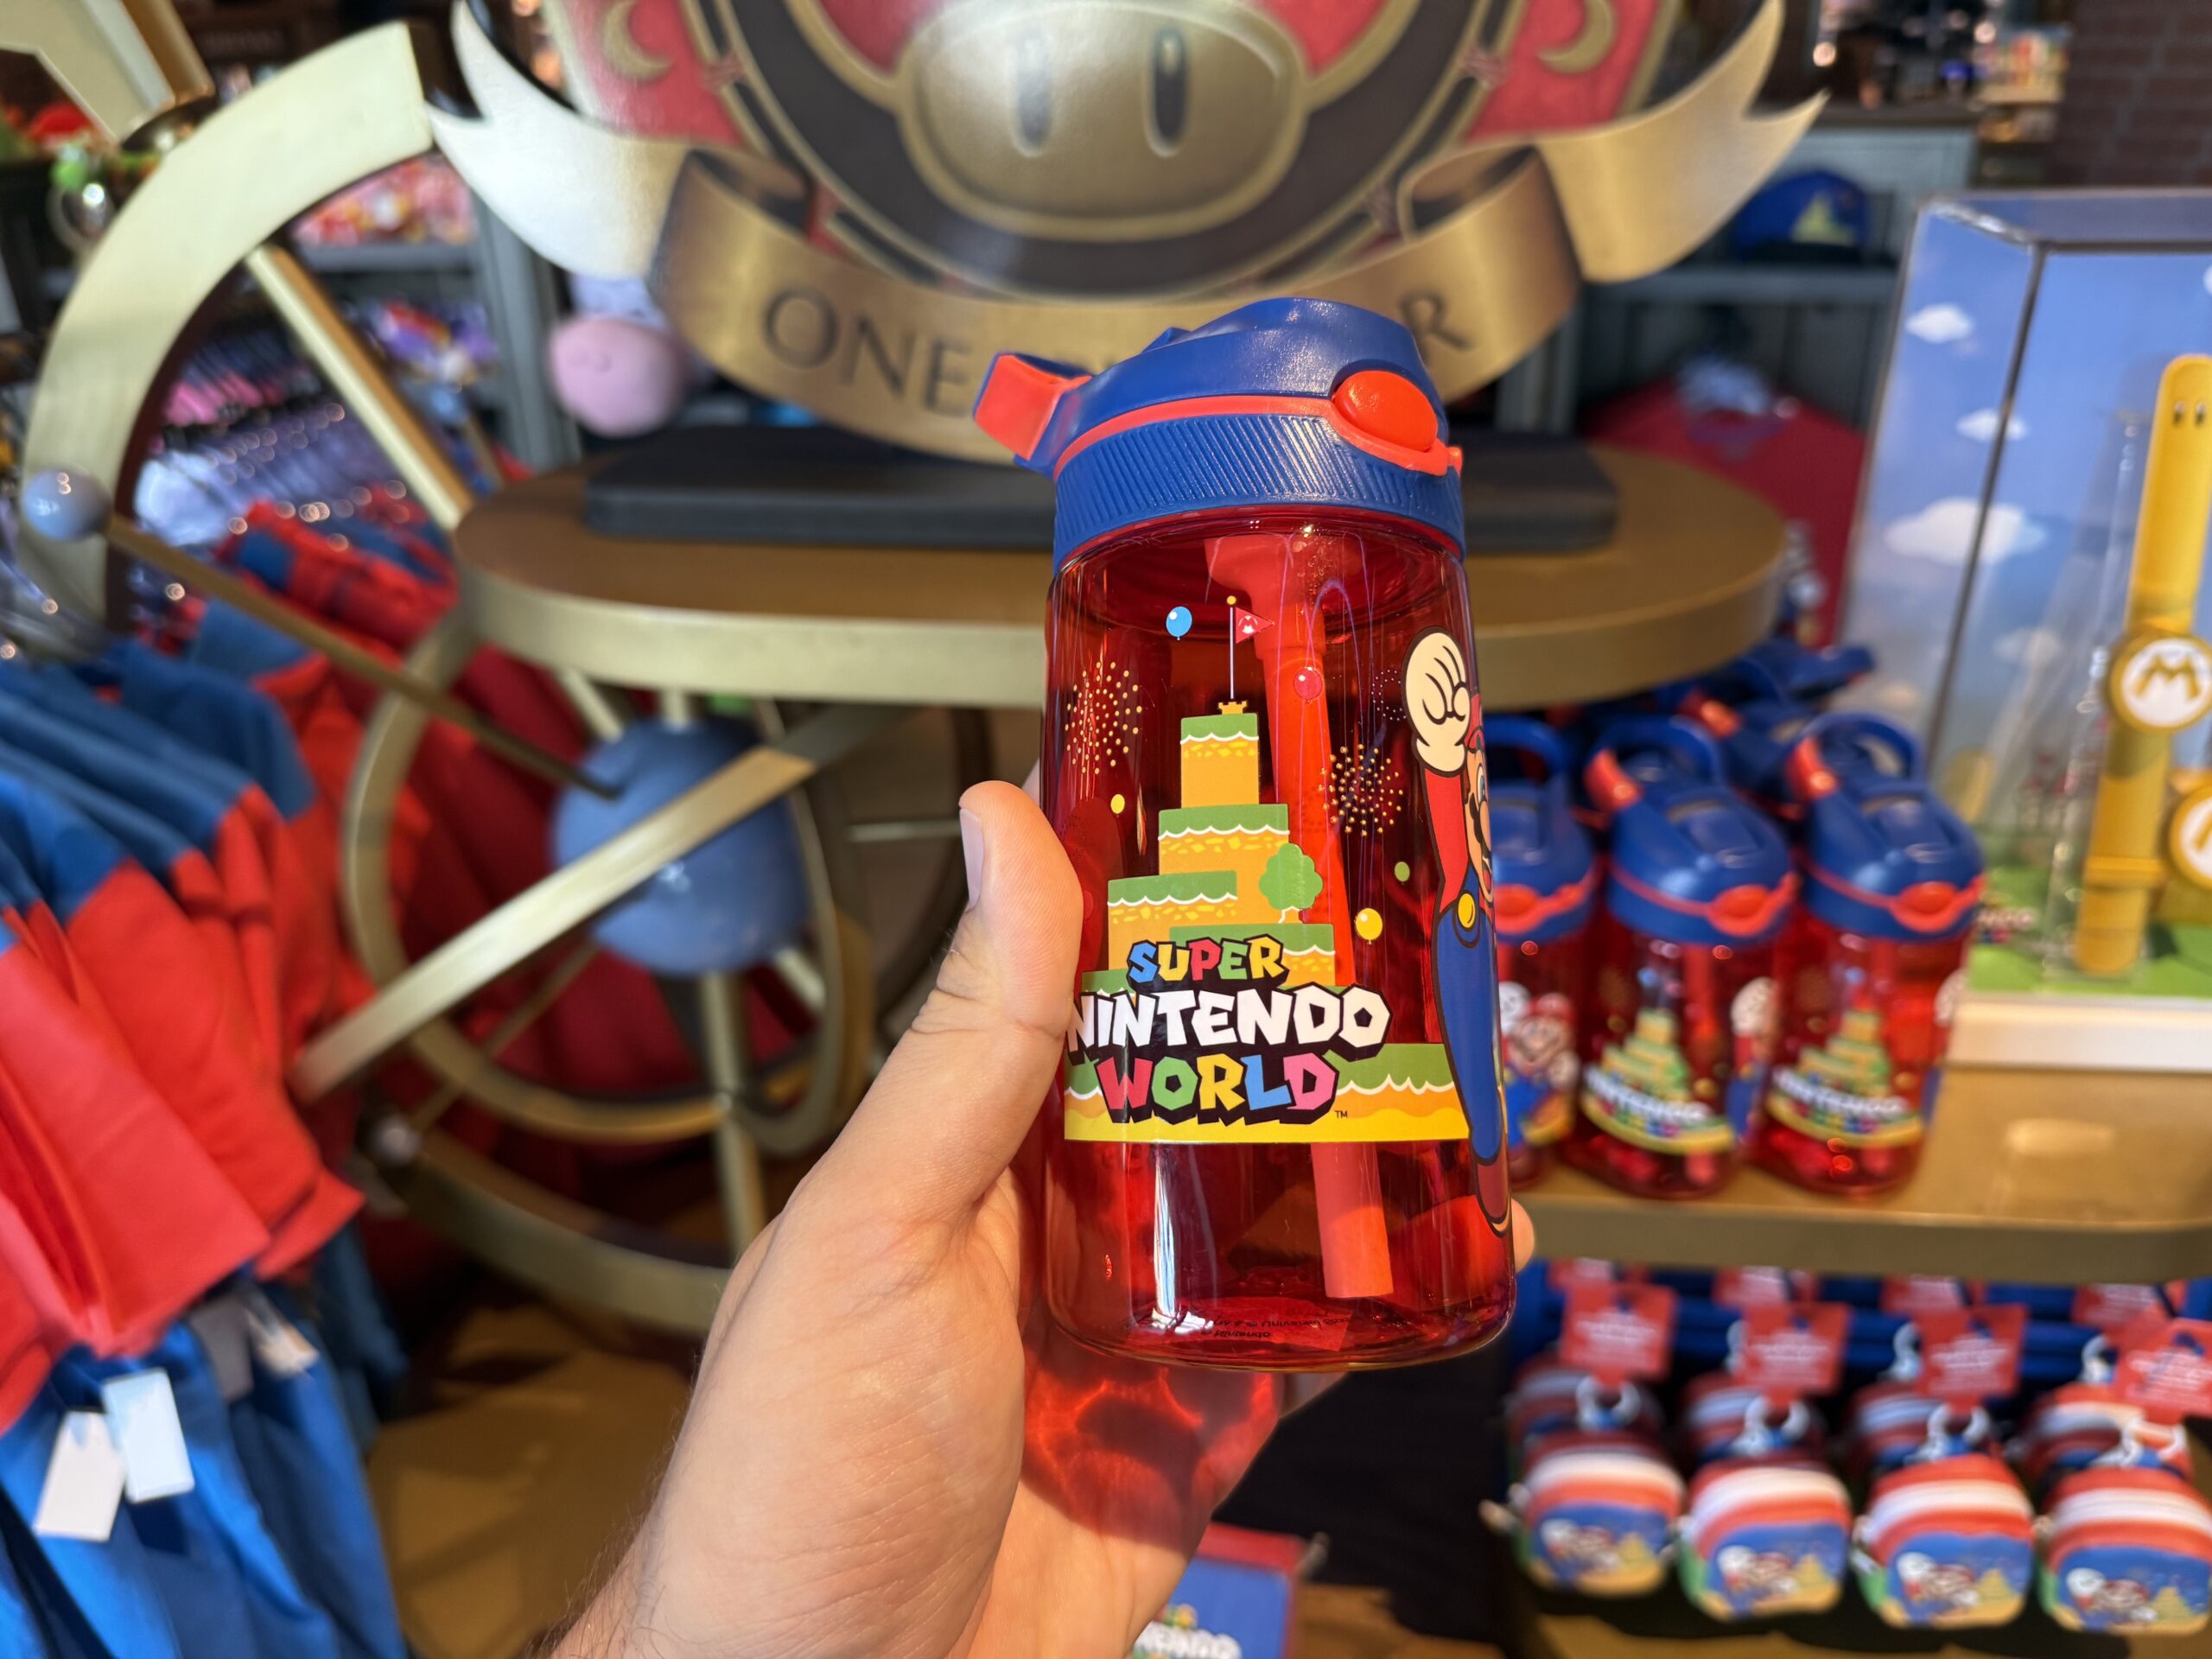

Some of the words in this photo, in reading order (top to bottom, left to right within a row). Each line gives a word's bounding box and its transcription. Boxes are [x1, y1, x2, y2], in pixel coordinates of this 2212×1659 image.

[759, 287, 974, 418] ONE
[1128, 934, 1287, 986] SUPER
[1066, 984, 1391, 1053] NINTENDO
[1095, 1052, 1338, 1112] WORLD
[1334, 1109, 1348, 1119] TM
